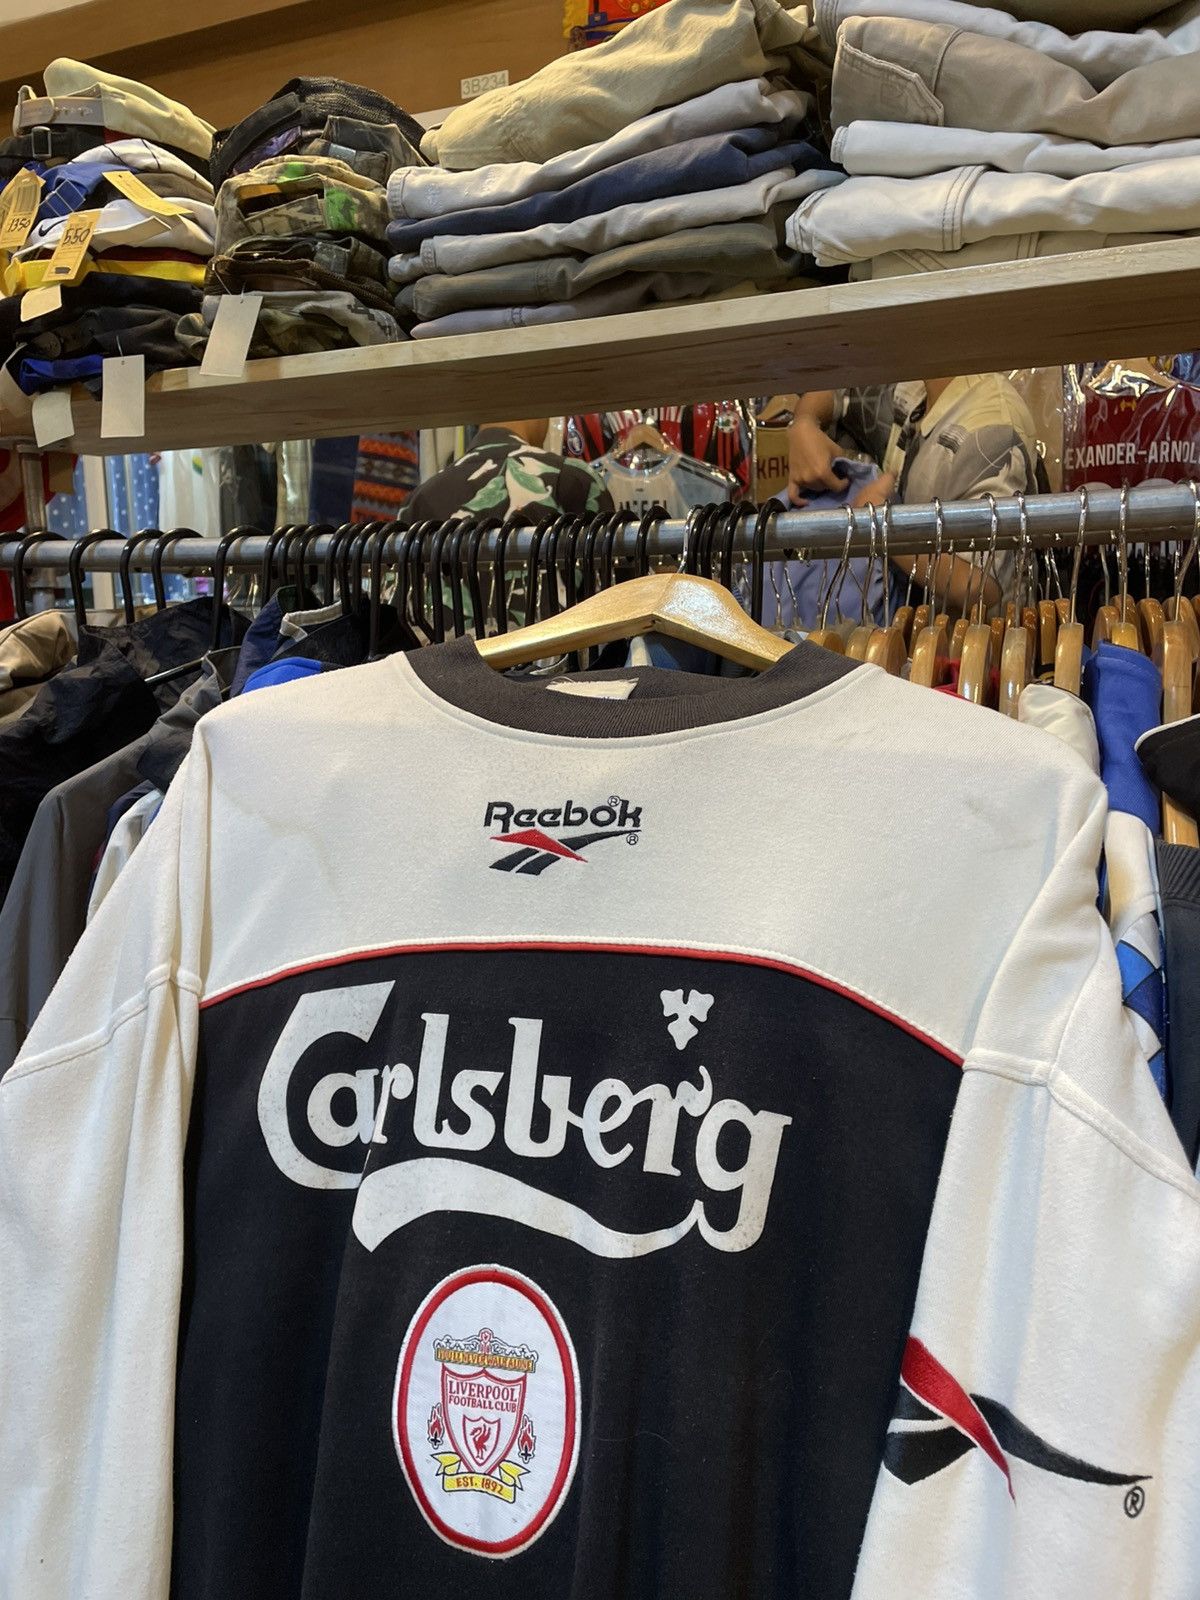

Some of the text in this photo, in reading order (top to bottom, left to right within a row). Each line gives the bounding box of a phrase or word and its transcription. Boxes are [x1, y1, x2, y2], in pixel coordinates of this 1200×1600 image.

[463, 73, 506, 95] 3B234
[62, 228, 91, 246] 550
[1064, 440, 1200, 470] EXANDER-ARNOL
[484, 799, 643, 833] Reebok
[257, 980, 793, 1252] Carlsberg
[448, 1380, 518, 1402] LIVERPOOL
[448, 1394, 517, 1413] FOOTBALL CLUB
[481, 1477, 504, 1496] 1892
